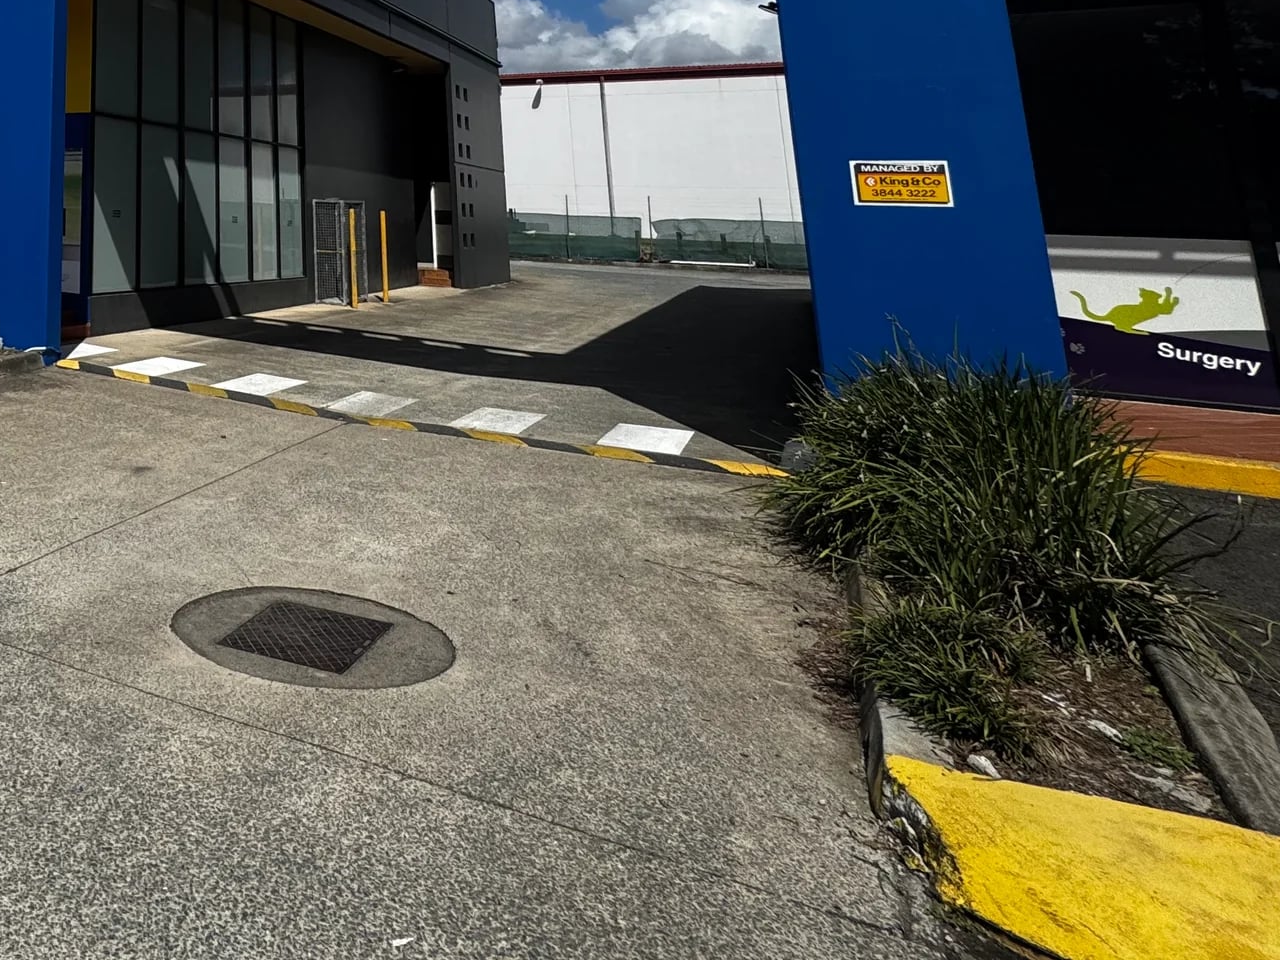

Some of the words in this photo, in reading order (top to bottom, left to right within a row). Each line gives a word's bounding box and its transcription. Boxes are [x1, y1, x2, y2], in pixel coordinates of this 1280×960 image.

[860, 164, 920, 173] MANAGED
[923, 164, 939, 173] BY
[879, 176, 909, 187] King
[922, 176, 941, 186] Co
[872, 188, 903, 197] 3844
[906, 189, 937, 198] 3222
[1157, 342, 1261, 377] Surgery
